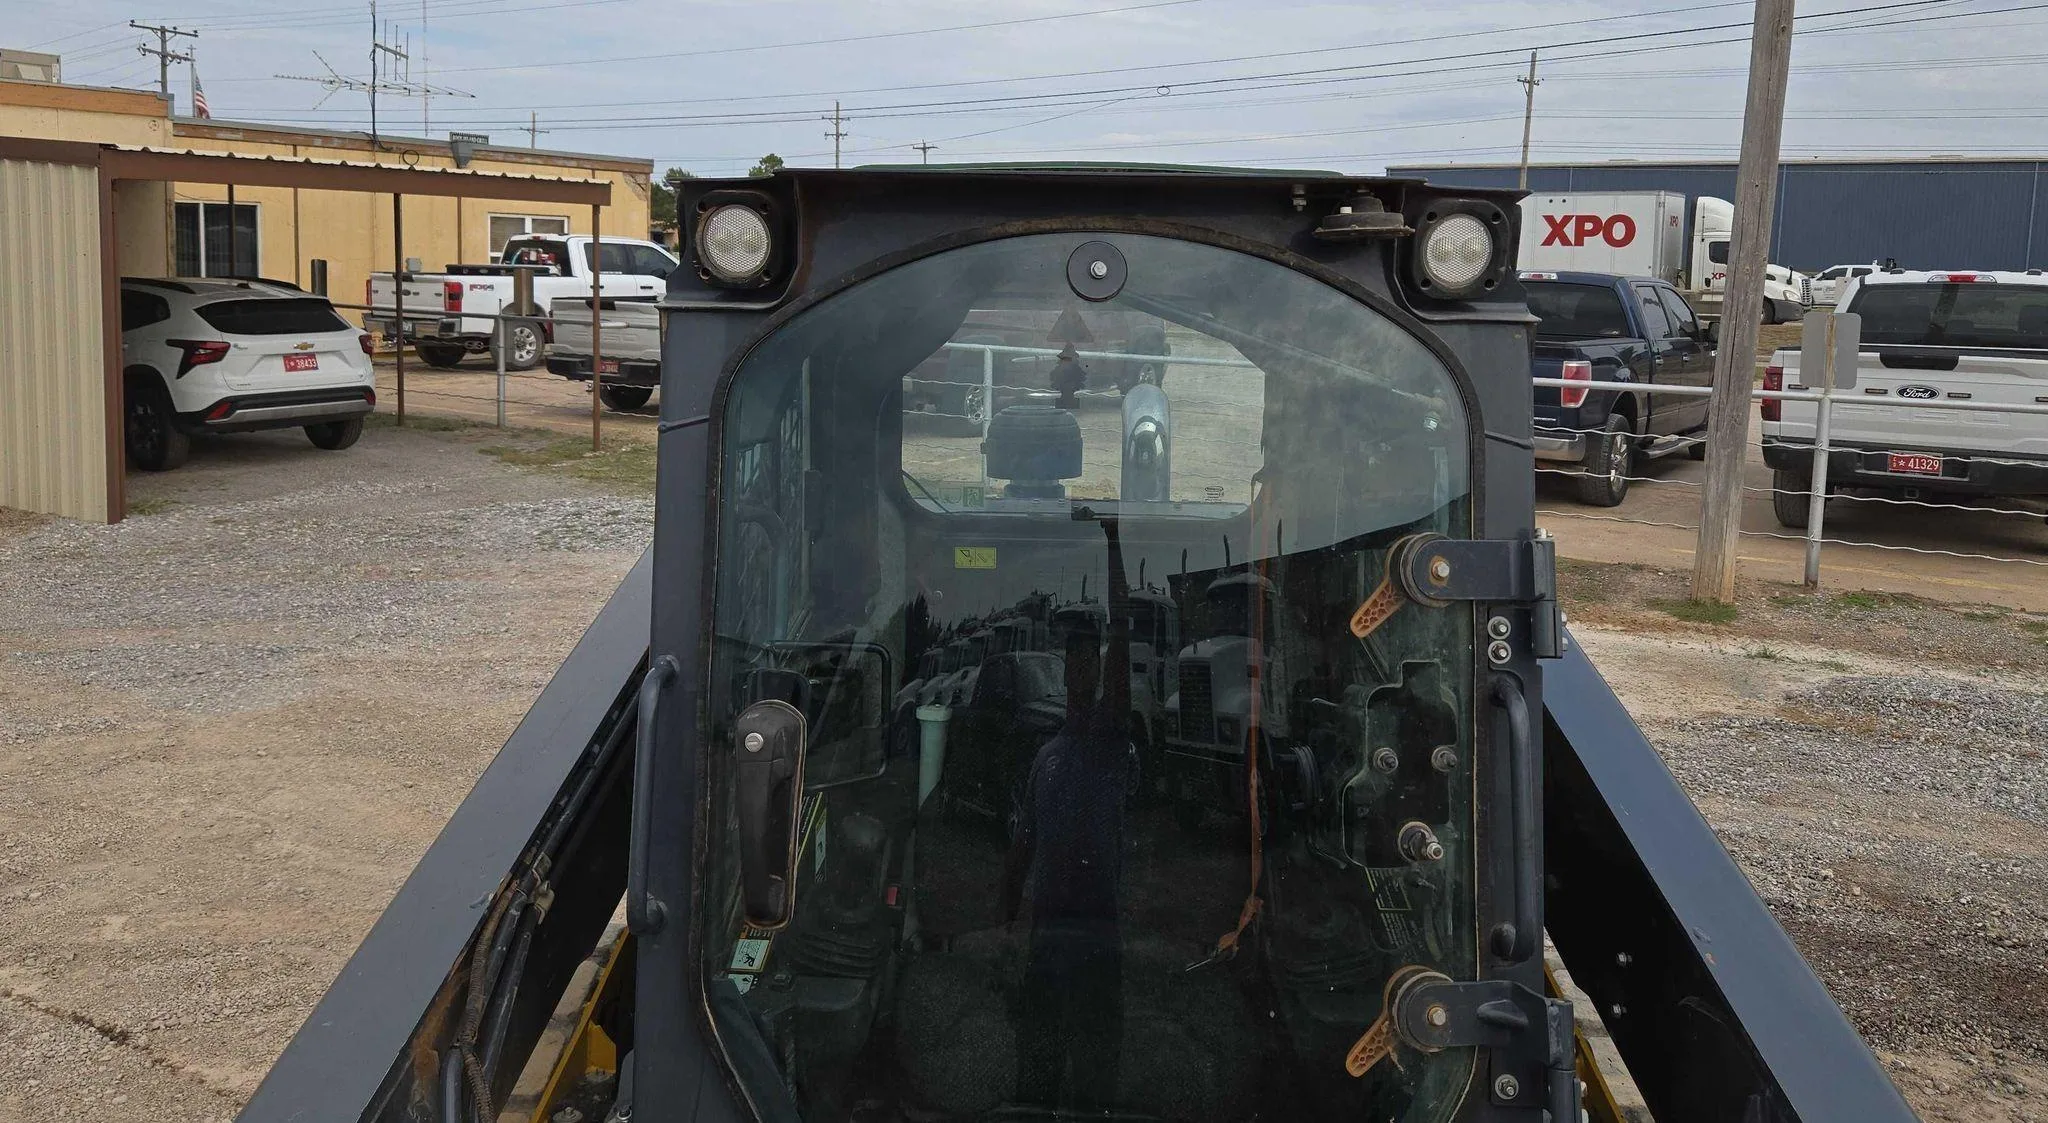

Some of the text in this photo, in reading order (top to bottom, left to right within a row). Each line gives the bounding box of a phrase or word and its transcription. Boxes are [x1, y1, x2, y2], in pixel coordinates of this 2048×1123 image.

[1669, 215, 1679, 228] XPO
[1540, 214, 1636, 248] XPO
[1711, 272, 1726, 280] XP
[296, 359, 317, 369] 38433
[1903, 388, 1931, 398] Ford
[1908, 457, 1940, 471] 41329
